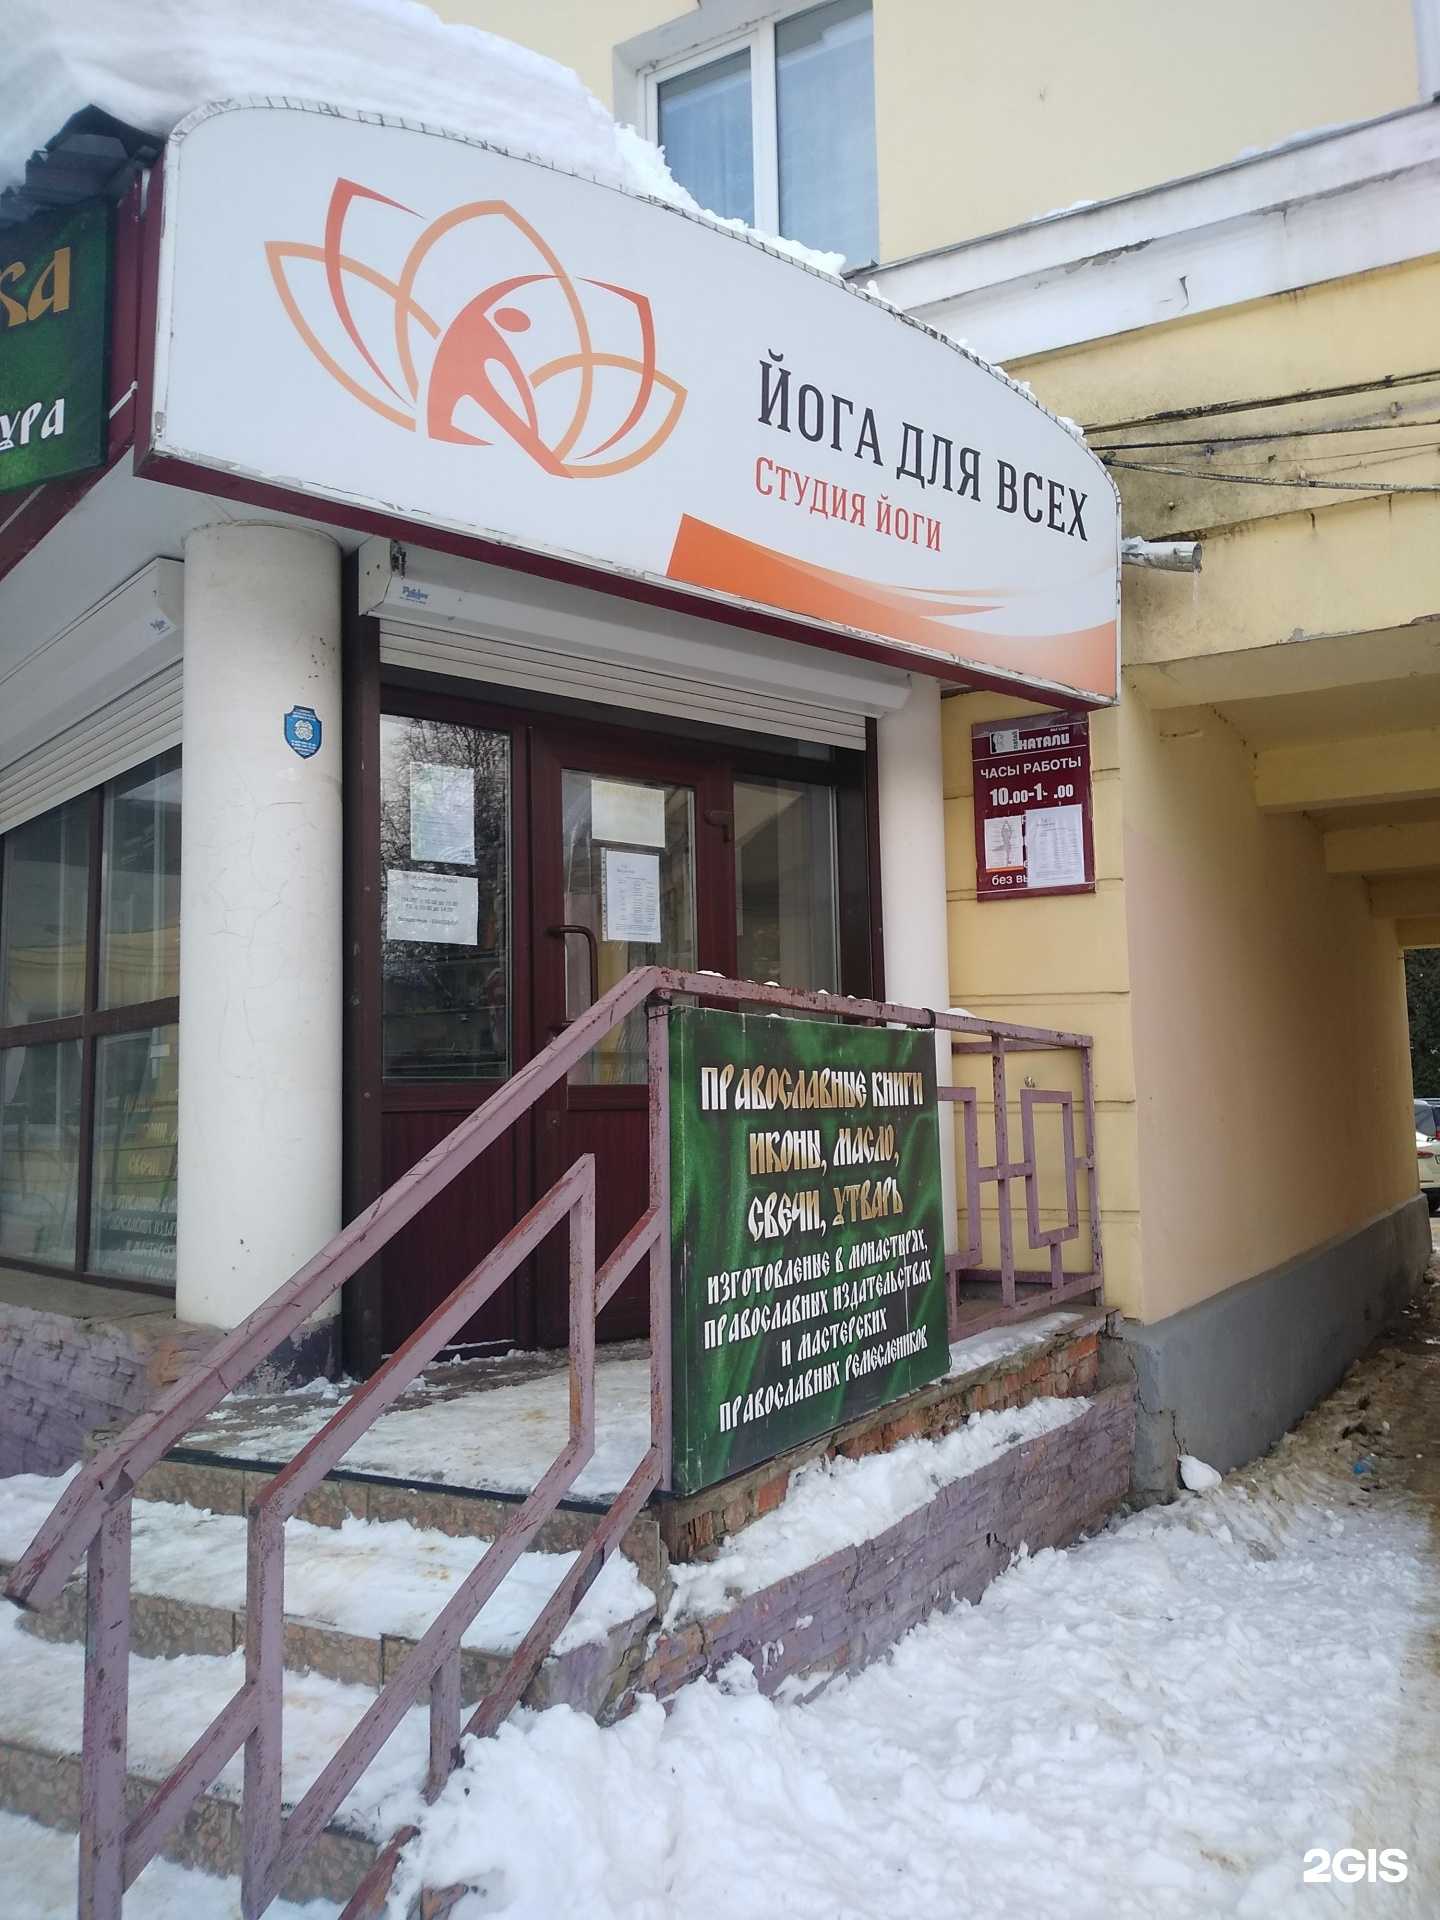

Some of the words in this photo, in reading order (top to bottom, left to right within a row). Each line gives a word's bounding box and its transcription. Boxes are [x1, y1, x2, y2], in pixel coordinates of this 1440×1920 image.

[757, 348, 884, 467] ЙОГА
[896, 421, 982, 503] ДЛЯ
[996, 459, 1089, 542] ВСЕХ
[754, 456, 866, 528] СТУДИЯ
[875, 495, 943, 553] ЙОГИ
[980, 764, 1020, 780] ЧАСЫ
[1023, 756, 1082, 776] РАБОТЫ
[989, 783, 1074, 807] 10.00-1.00
[991, 874, 1012, 886] без
[701, 1063, 867, 1110] ПРАВОСЛАВНЫЕ
[871, 1071, 924, 1108] КНИГИ
[749, 1129, 827, 1176] ИКОНЫ,
[833, 1124, 899, 1168] МАСЛО,
[748, 1189, 827, 1241] СВЕЧИ,
[832, 1176, 904, 1226] УТВАРЬ
[835, 1246, 844, 1273] В
[849, 1228, 928, 1271] МОНАСТЫРЯХ,
[704, 1289, 829, 1350] ПРАВОСЛАВНЫХ
[833, 1259, 932, 1312] ИЗДАТЕЛЬСТВАХ
[781, 1338, 791, 1367] И
[798, 1307, 888, 1361] МАСТЕРСКИХ
[719, 1361, 840, 1433] ПРАВОСЛАВНЫХ
